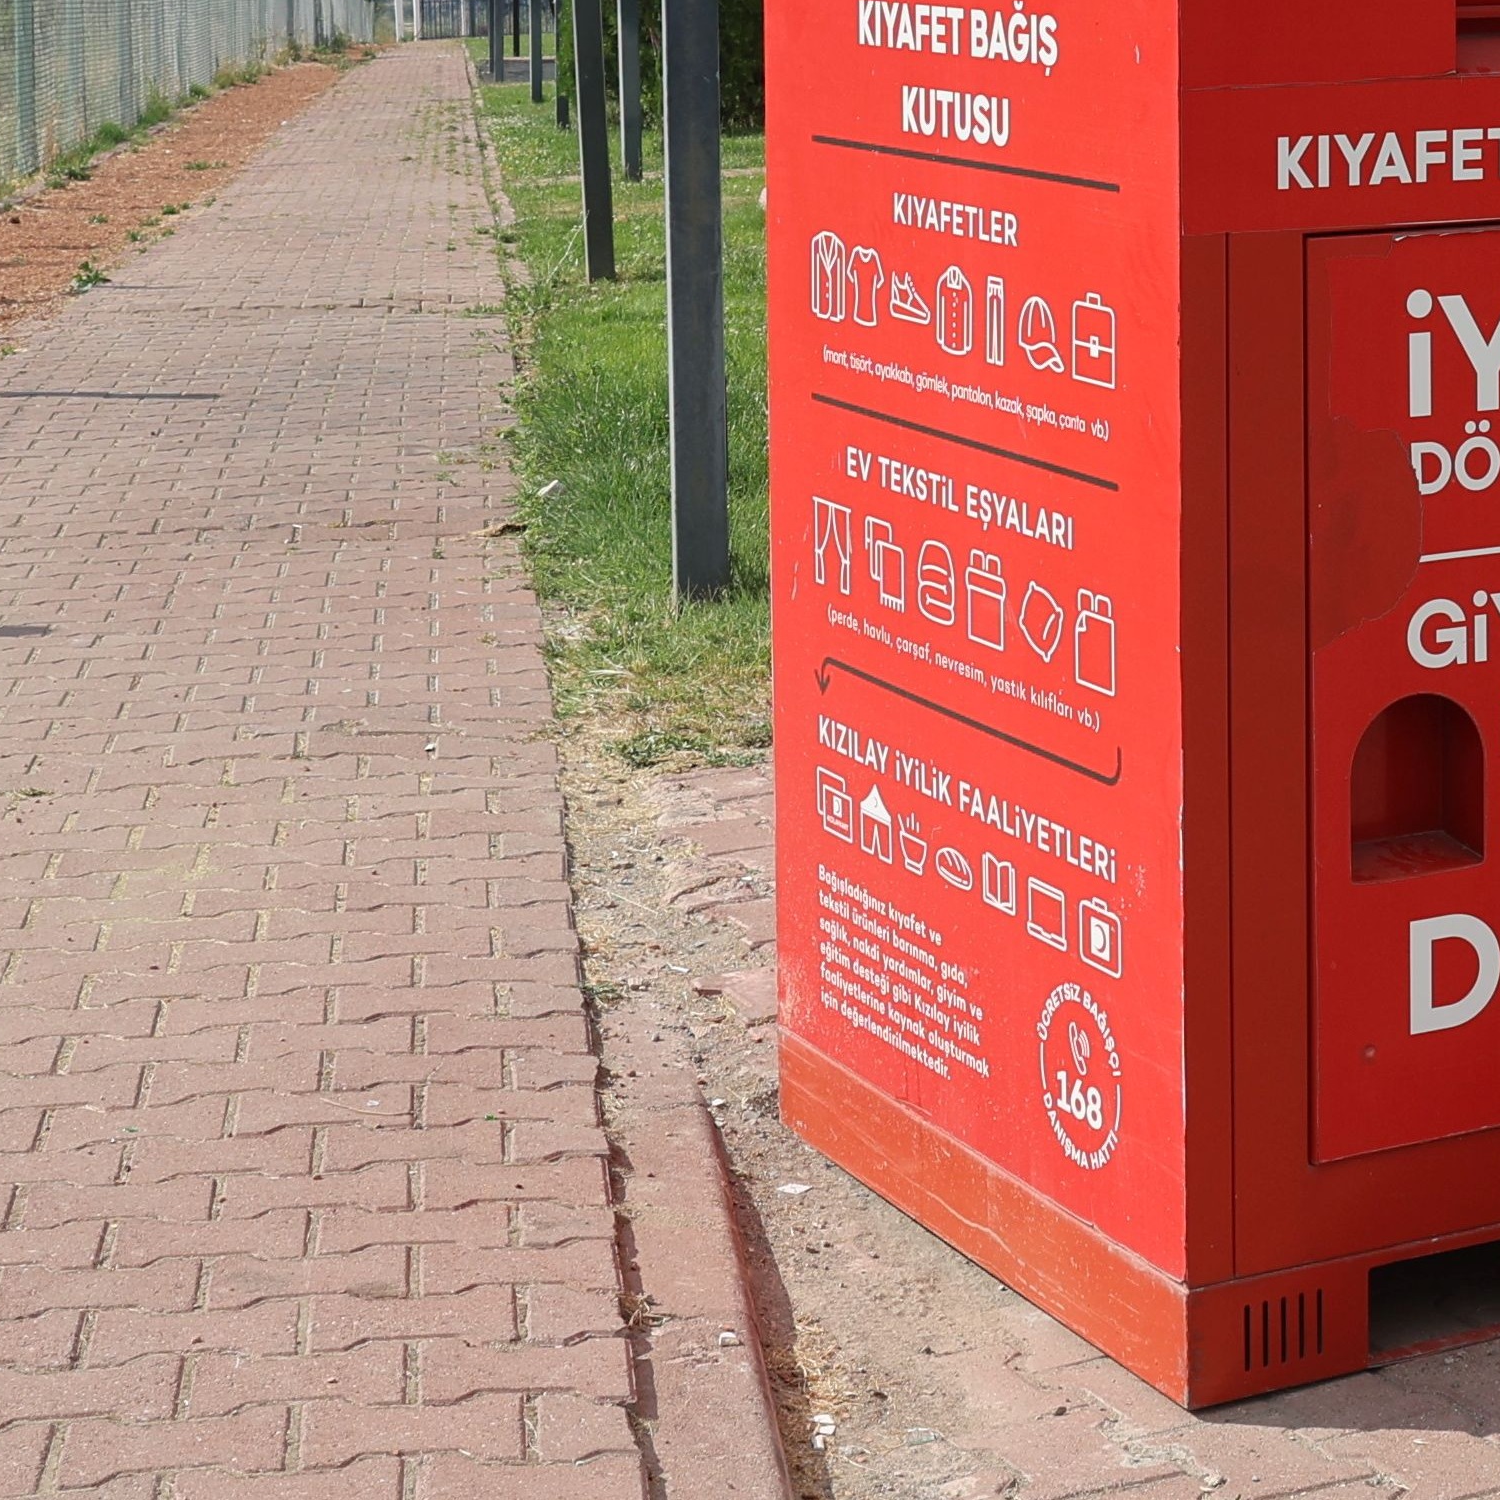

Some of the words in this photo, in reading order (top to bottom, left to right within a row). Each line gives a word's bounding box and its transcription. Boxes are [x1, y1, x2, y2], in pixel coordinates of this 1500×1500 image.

[969, 0, 1059, 77] BAĞIŞ
[901, 85, 1010, 147] KUTUSU
[893, 192, 1018, 247] KIYAFETLER
[951, 384, 994, 410] pantolon,
[994, 390, 1025, 419] kazak,
[1026, 403, 1058, 427] şapka,
[1059, 413, 1086, 433] çanta
[846, 445, 872, 482] EV
[877, 455, 960, 513] TEKSTİL
[966, 484, 1073, 550] EŞYALARI
[827, 603, 861, 635] (perde,
[863, 618, 893, 649] havlu,
[896, 636, 932, 665] çarşaf,
[935, 652, 988, 687] nevresim,
[990, 674, 1027, 701] yastık
[1030, 685, 1073, 720] kılıfları
[1077, 708, 1100, 733] vb.)
[818, 714, 889, 774] KIZILAY
[818, 863, 887, 916] Bağışladığınız
[888, 902, 927, 938] kıyafet
[928, 928, 942, 946] ve
[818, 889, 850, 920] tekstil
[852, 907, 890, 943] ürünleri
[892, 929, 938, 973] barınma,
[940, 961, 968, 989] gıda,
[819, 917, 851, 947] sağlık,
[852, 936, 880, 962] nakdi
[882, 952, 934, 996] yardımlar,
[936, 982, 967, 1012] giyim
[969, 1002, 983, 1021] ve
[820, 940, 851, 970] eğitim
[852, 957, 890, 996] desteği
[892, 982, 912, 1006] gibi
[914, 992, 950, 1033] Kızılay
[953, 1014, 981, 1047] iyilik
[820, 985, 838, 1011] için
[820, 961, 886, 1015] faaliyetlerine
[888, 1001, 926, 1040] kaynak
[928, 1029, 990, 1079] oluşturmak
[1082, 990, 1122, 1077] BAĞIŞÇI
[1043, 1091, 1089, 1170] DANIŞMA
[1089, 1129, 1119, 1170] HATTI
[1056, 1070, 1103, 1130] 168
